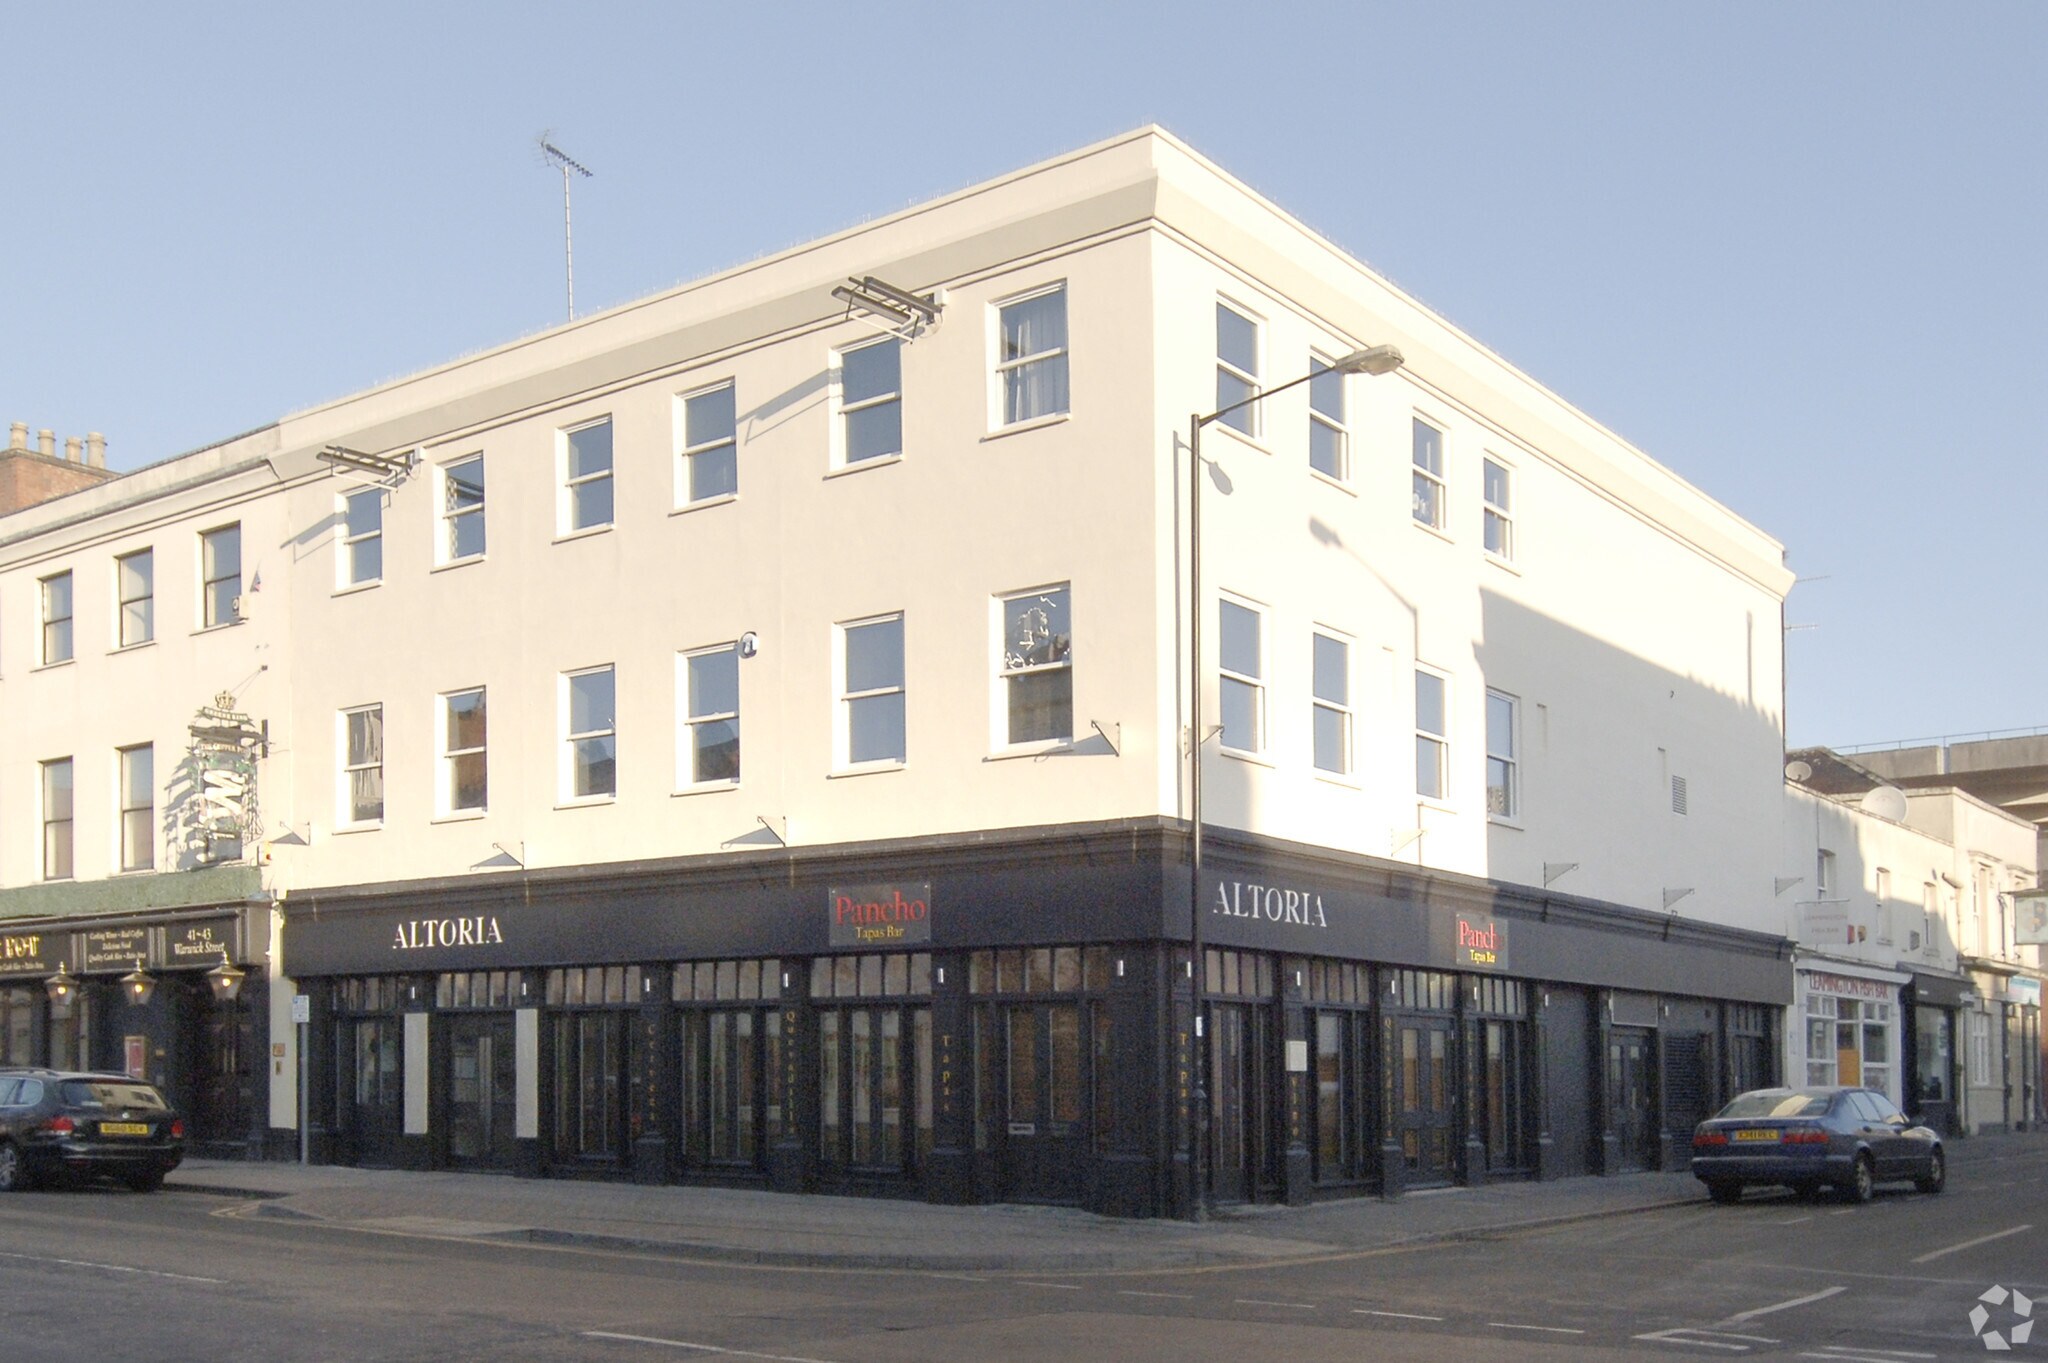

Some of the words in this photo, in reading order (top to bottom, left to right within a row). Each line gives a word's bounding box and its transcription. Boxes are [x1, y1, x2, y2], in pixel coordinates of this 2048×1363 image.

[836, 891, 927, 925] Pancho
[1213, 881, 1327, 927] ALTORIA
[174, 941, 204, 955] Warwick
[204, 941, 225, 953] Street
[392, 916, 503, 949] ALTORIA
[856, 927, 885, 941] Tapas
[887, 924, 904, 938] Bar
[1810, 972, 1859, 995] LEAMINGTON
[1876, 981, 1889, 999] BAR
[941, 1035, 952, 1112] Tapas
[1179, 1033, 1189, 1115] Tapas
